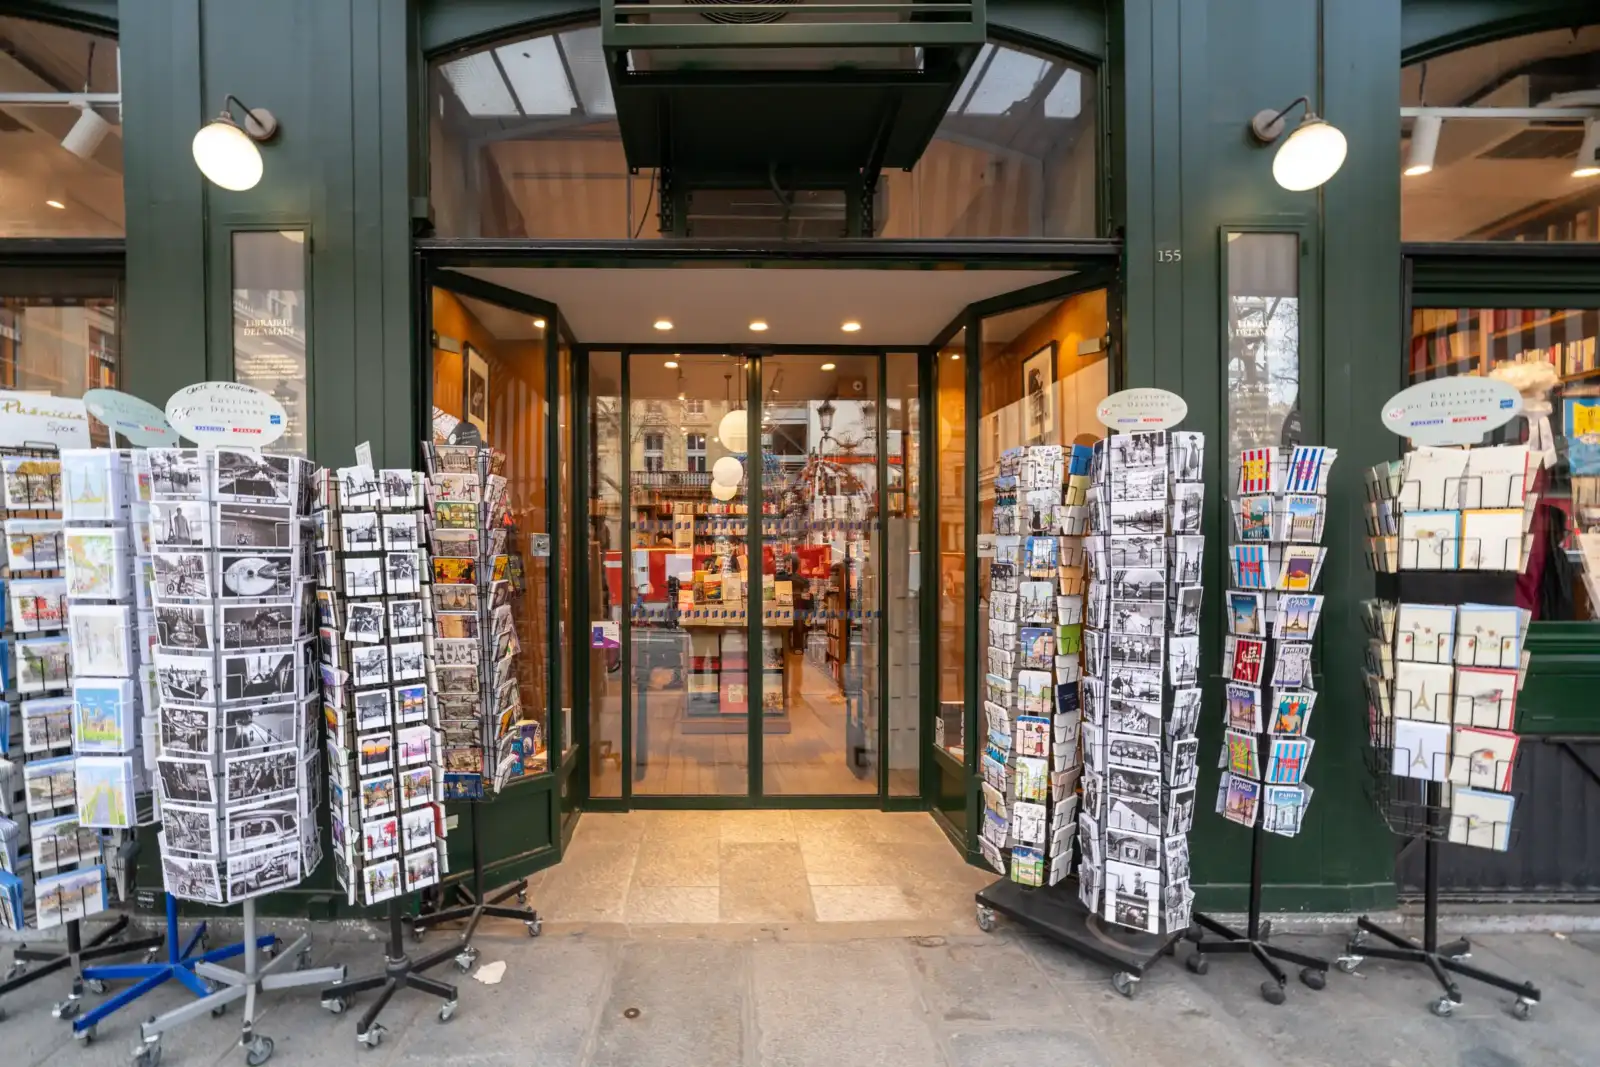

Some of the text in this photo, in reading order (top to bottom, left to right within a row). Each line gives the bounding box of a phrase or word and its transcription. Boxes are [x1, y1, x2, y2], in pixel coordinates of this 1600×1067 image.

[1158, 249, 1181, 262] 155
[1284, 646, 1307, 654] PARIS
[1280, 695, 1308, 704] PARIS
